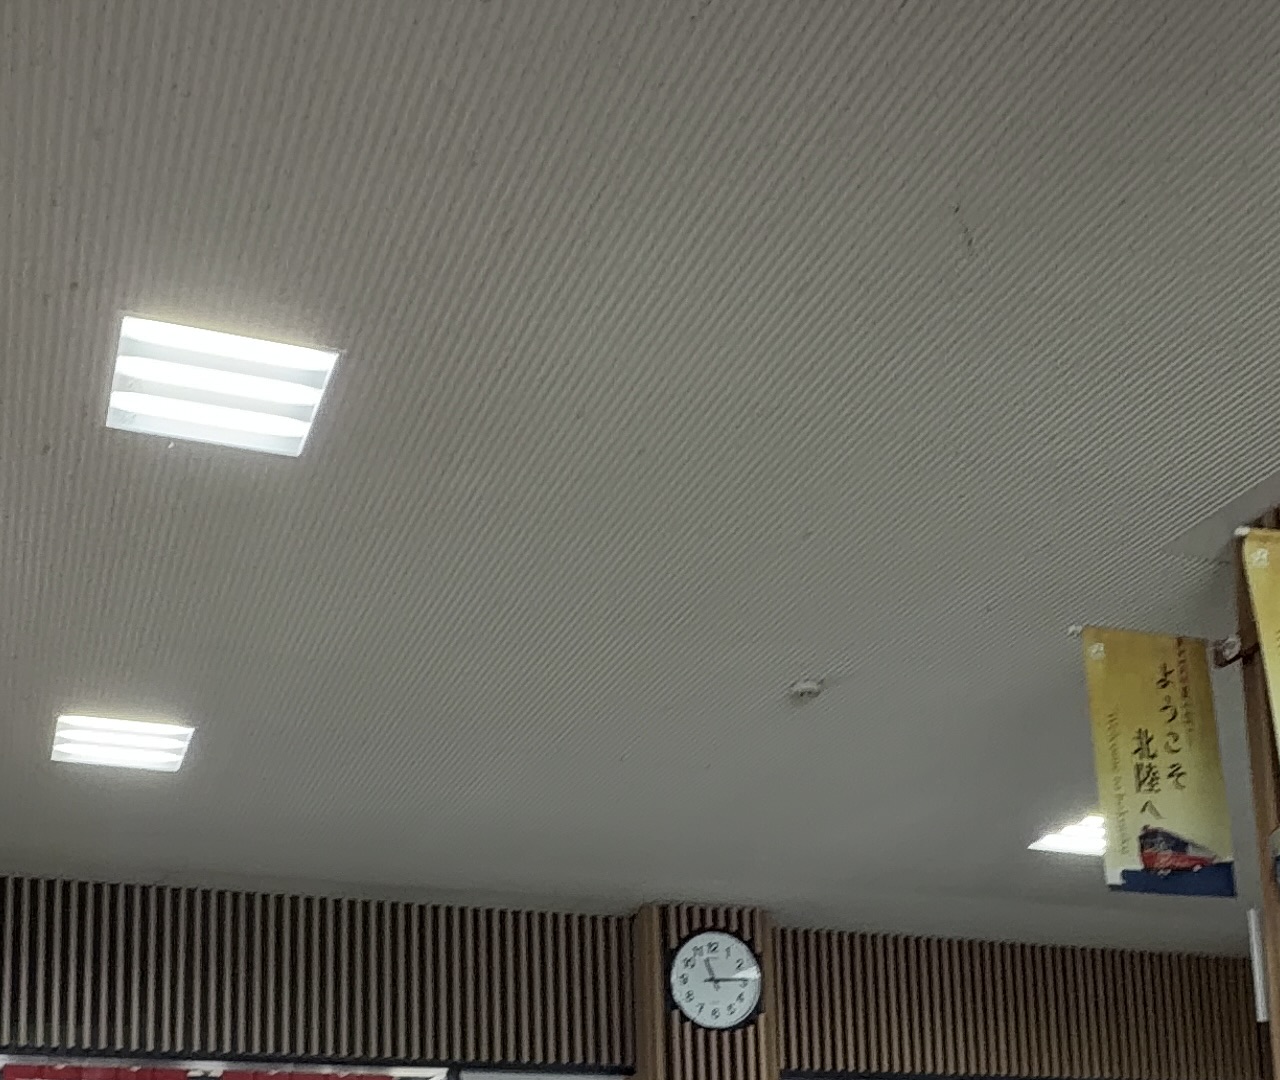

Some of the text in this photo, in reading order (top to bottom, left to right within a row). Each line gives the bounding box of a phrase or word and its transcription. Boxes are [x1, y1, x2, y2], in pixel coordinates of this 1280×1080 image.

[1131, 728, 1166, 820] 北陸へ
[1156, 662, 1187, 790] ようこそ
